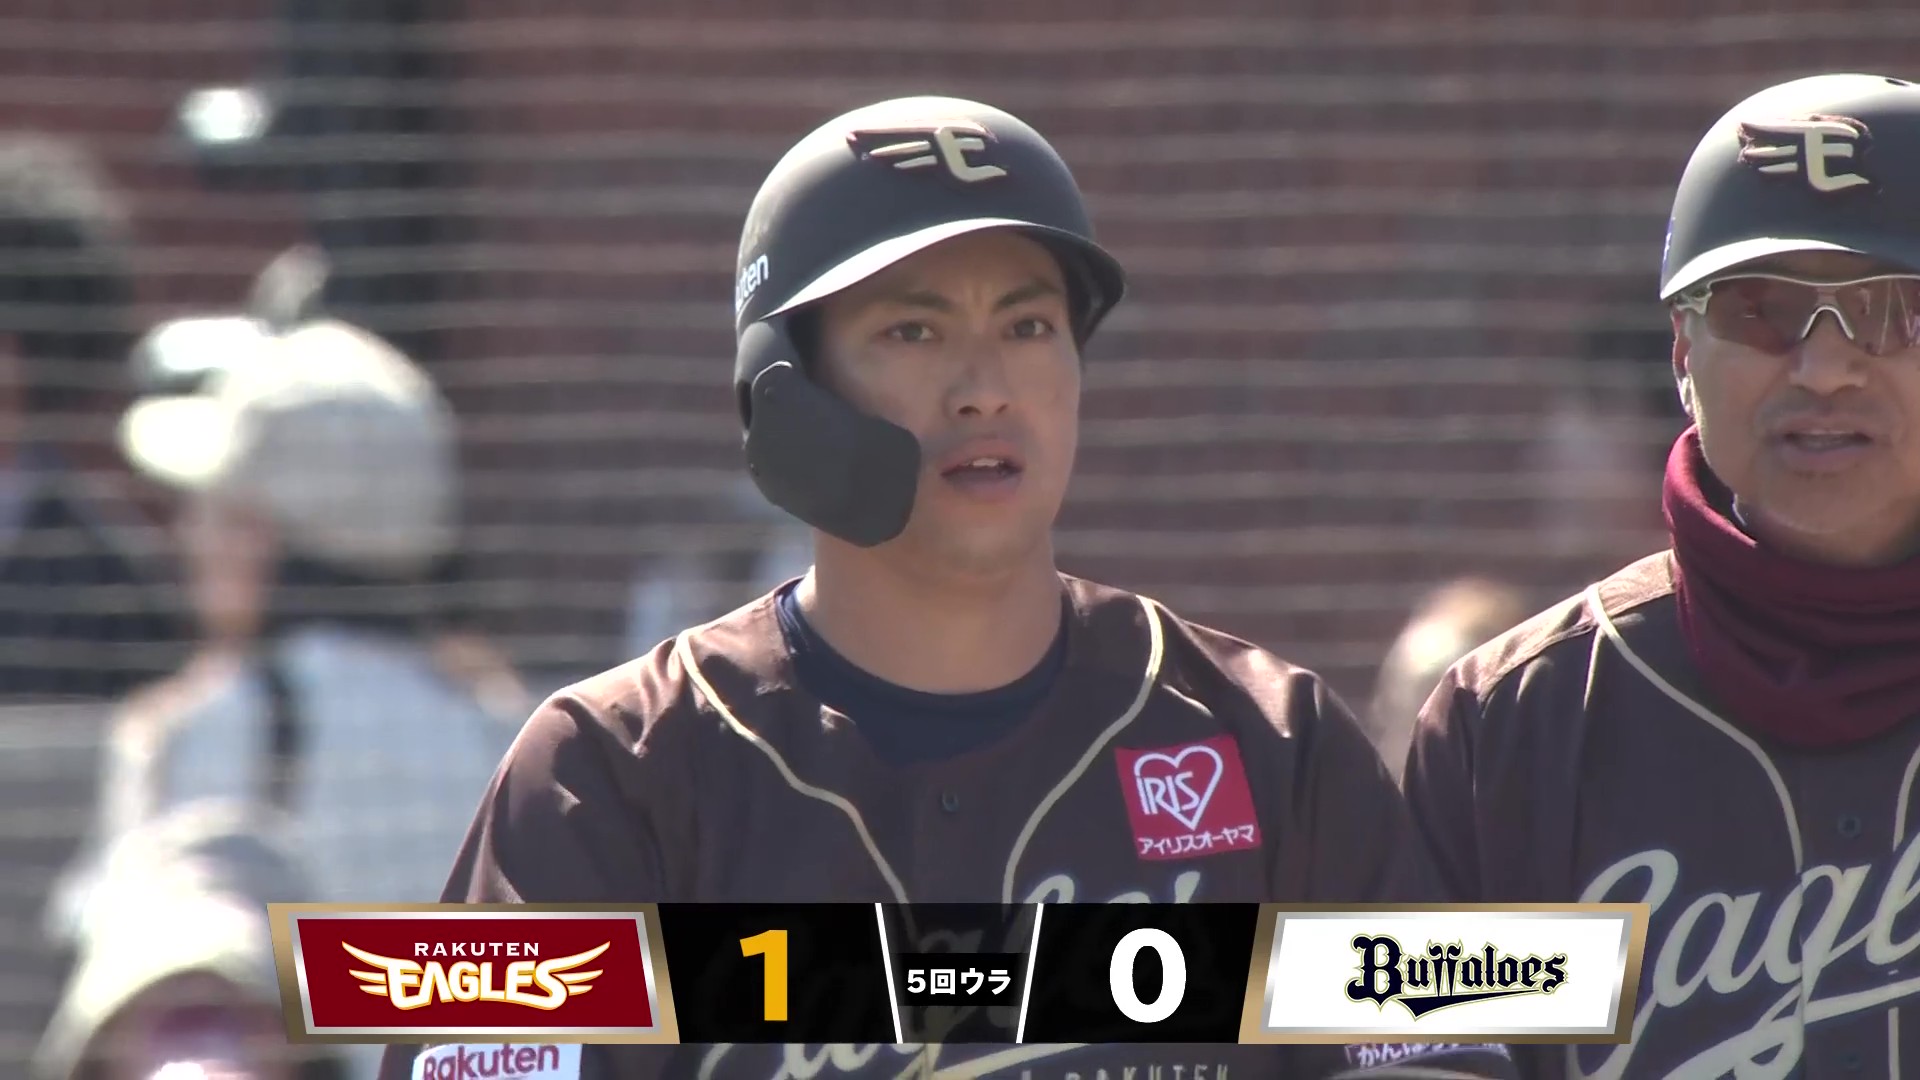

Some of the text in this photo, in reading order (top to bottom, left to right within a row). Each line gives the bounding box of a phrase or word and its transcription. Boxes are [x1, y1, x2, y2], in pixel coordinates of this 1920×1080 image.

[1136, 771, 1200, 815] IRIS
[1138, 824, 1255, 855] アイリスオーヤマ
[423, 1042, 561, 1080] Rakuten
